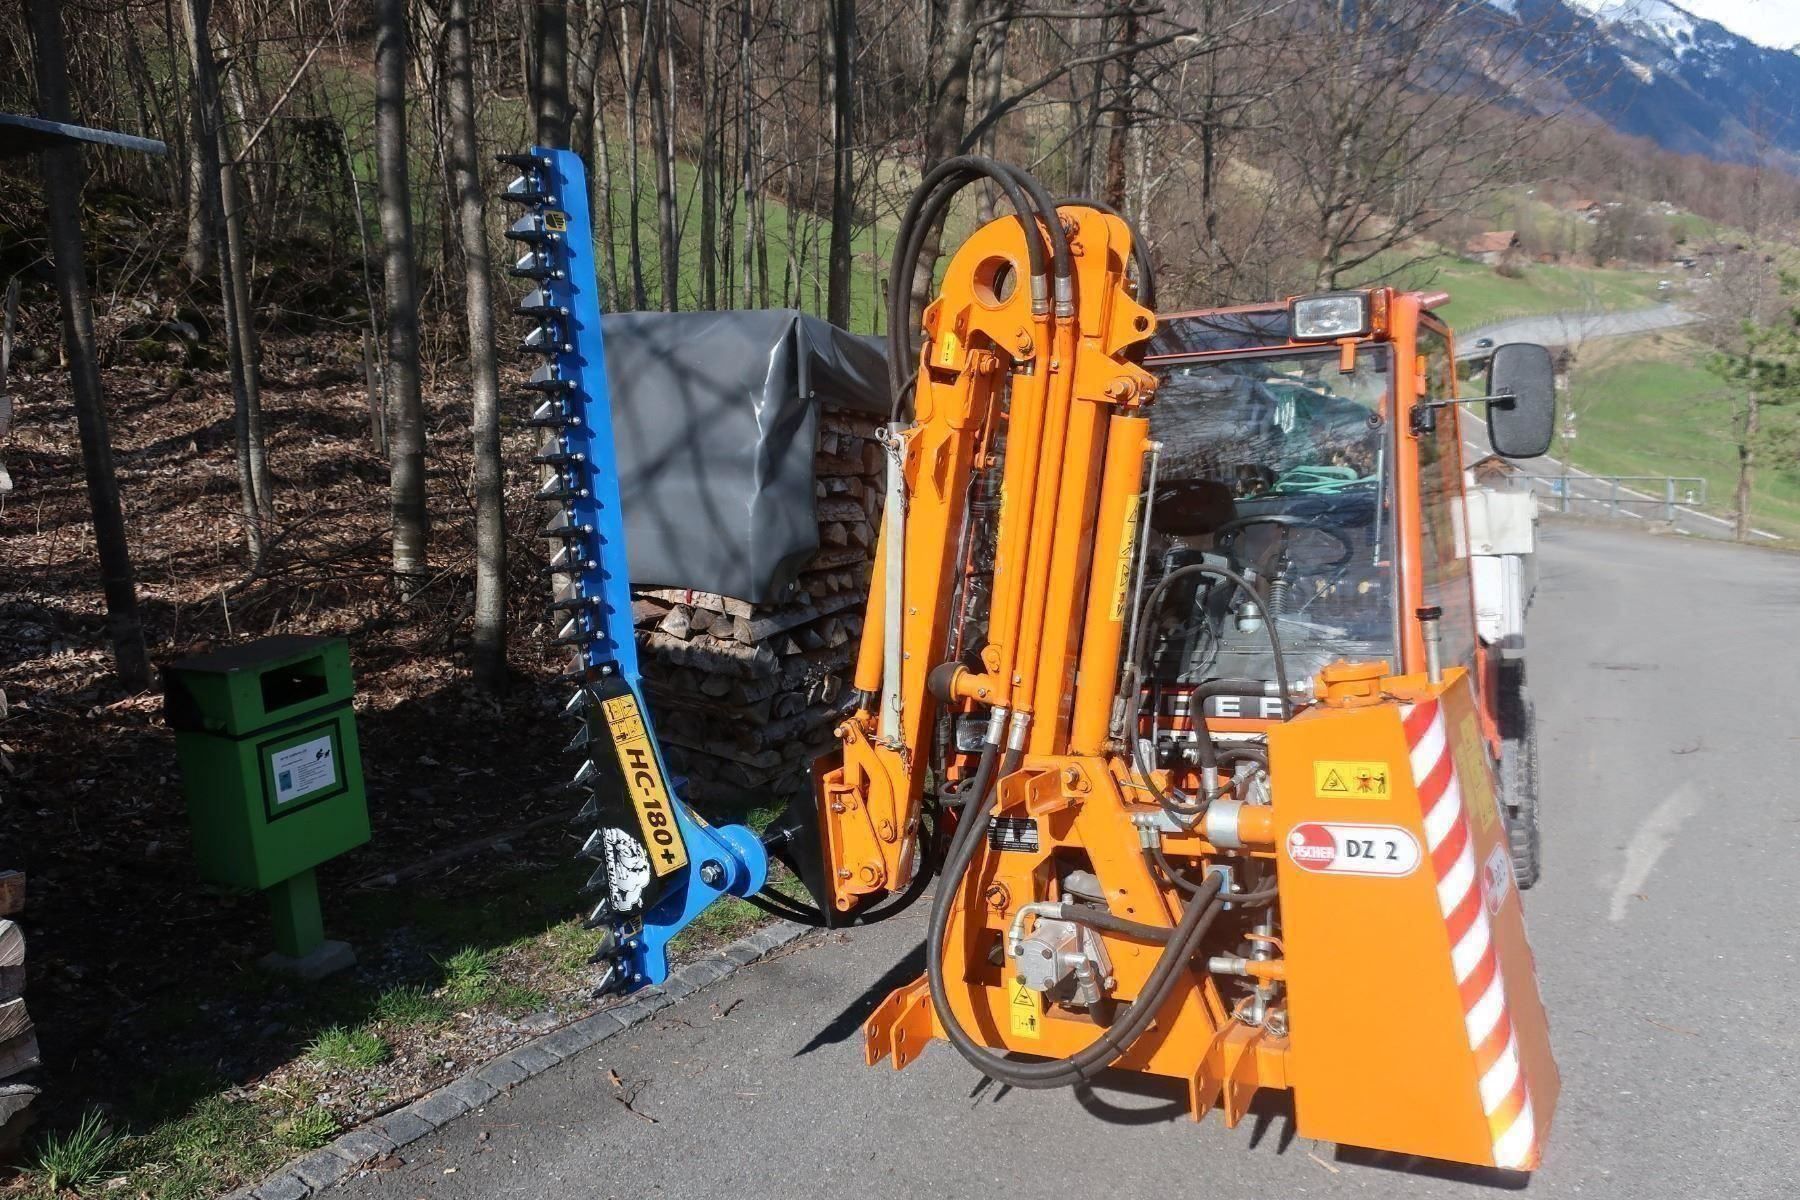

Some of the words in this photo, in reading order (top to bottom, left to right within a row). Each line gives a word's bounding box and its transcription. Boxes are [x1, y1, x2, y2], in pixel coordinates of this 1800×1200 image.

[626, 748, 675, 864] HC-180+
[1346, 839, 1375, 859] DZ
[1384, 841, 1398, 860] 2
